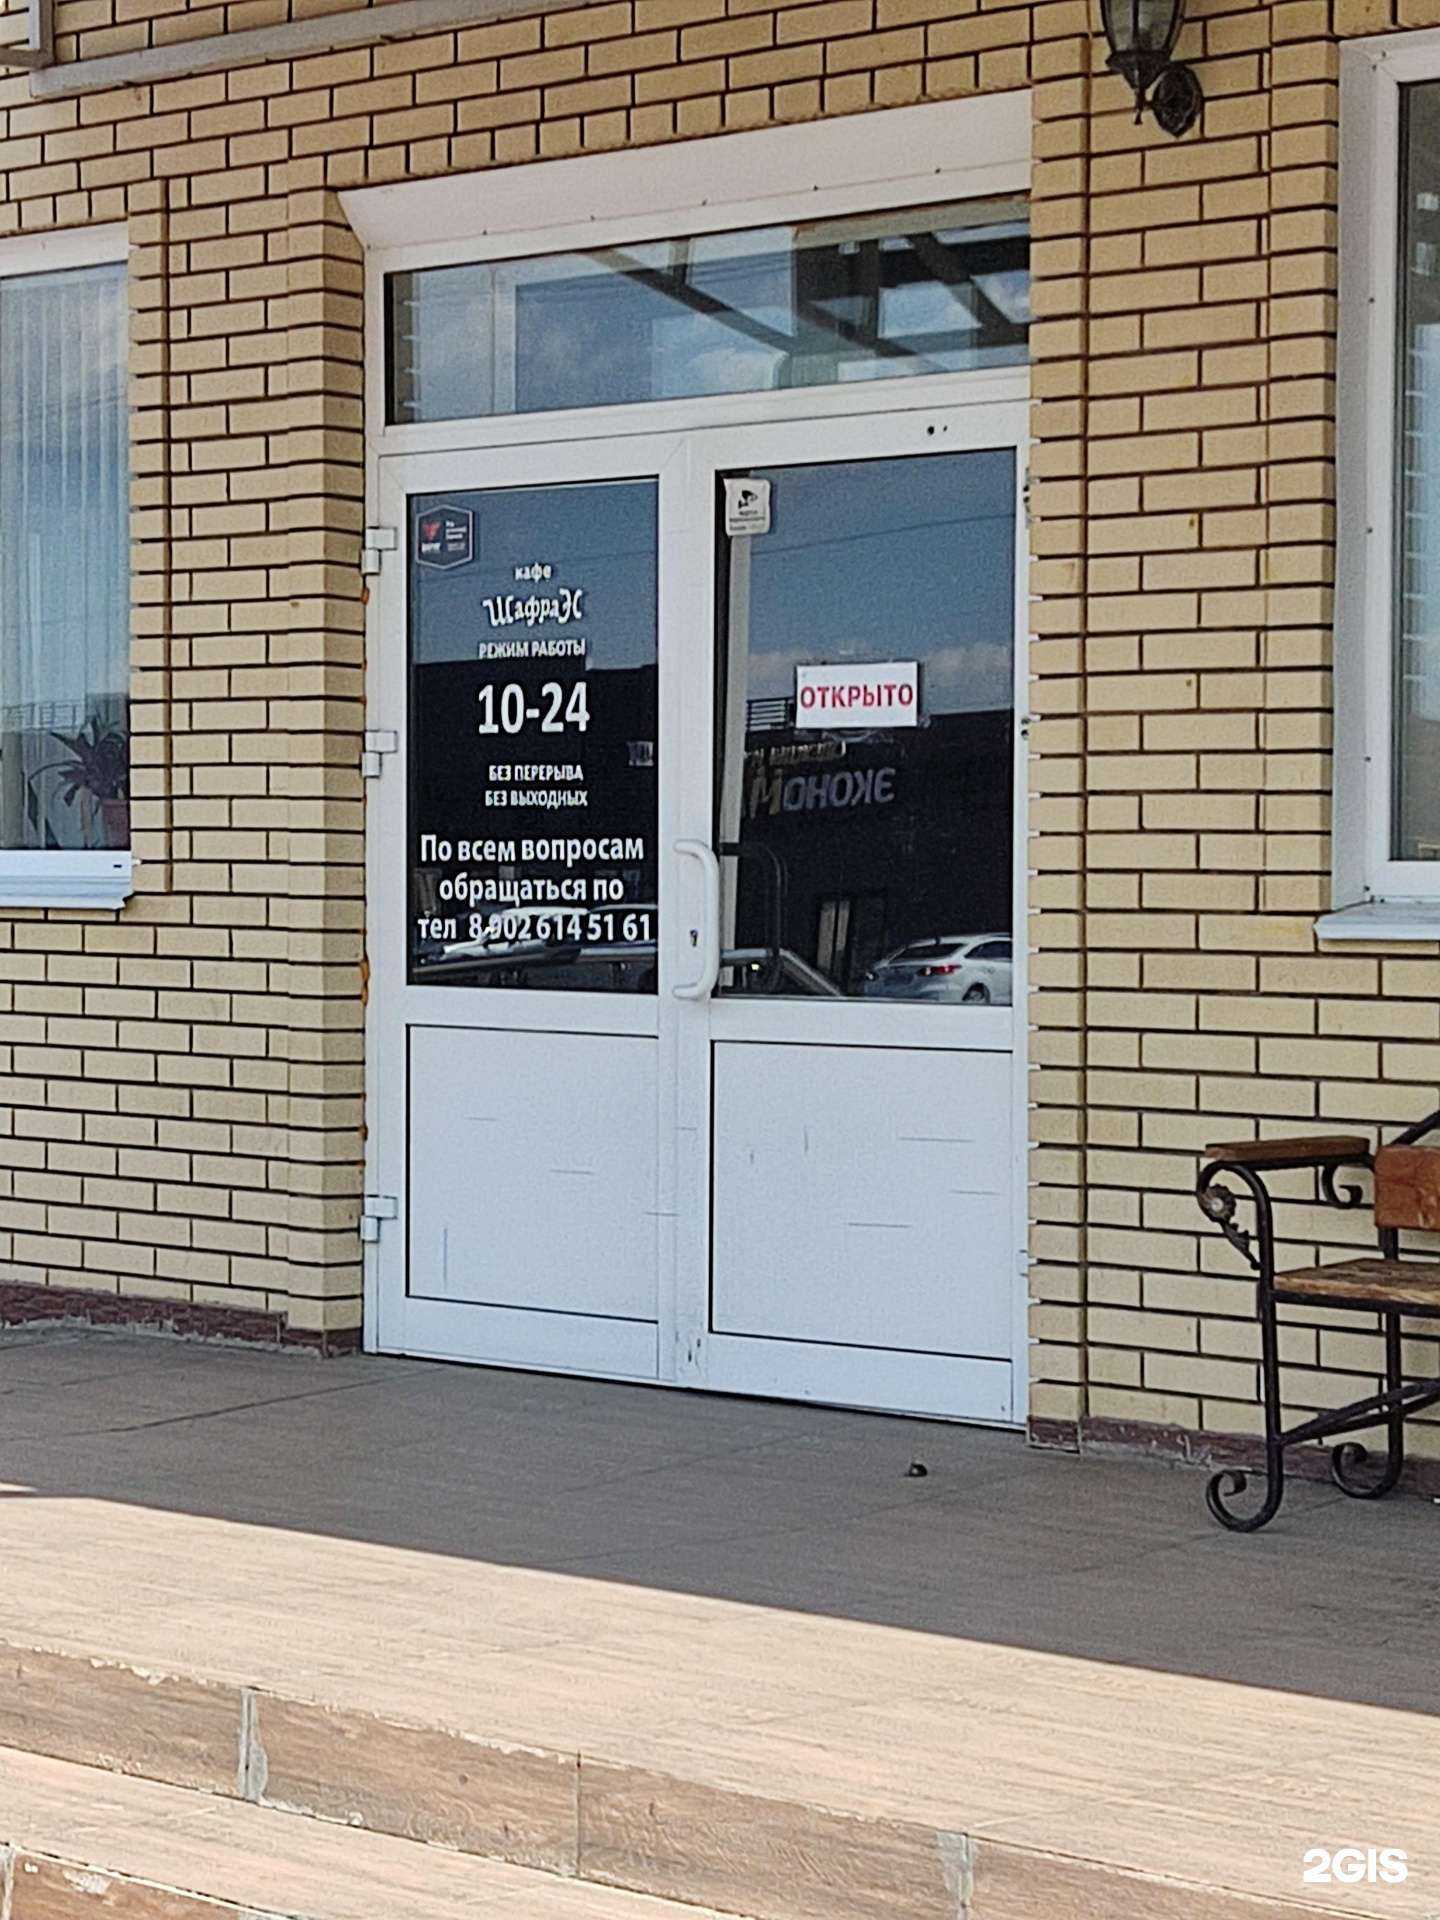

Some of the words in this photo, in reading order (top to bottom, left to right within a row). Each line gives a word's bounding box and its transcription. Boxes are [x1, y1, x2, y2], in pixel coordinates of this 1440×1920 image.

[515, 562, 552, 582] кафе
[479, 641, 529, 659] РЕЖИМ
[531, 638, 586, 657] РАБОТЫ
[478, 681, 591, 735] 10-24
[799, 683, 914, 709] ОТКРЫТО
[488, 764, 511, 782] БЕЗ
[514, 764, 584, 782] ПЕРЕРЫВА
[485, 789, 508, 807] БЕЗ
[510, 789, 589, 809] ВЫХОДНЫХ
[420, 834, 452, 862] По
[457, 839, 516, 862] всем
[521, 837, 644, 868] вопросам
[439, 871, 587, 908] обращаться
[592, 878, 624, 901] по
[417, 916, 457, 940] тел
[536, 913, 582, 941] 614
[586, 913, 615, 941] 51
[622, 913, 651, 941] 61
